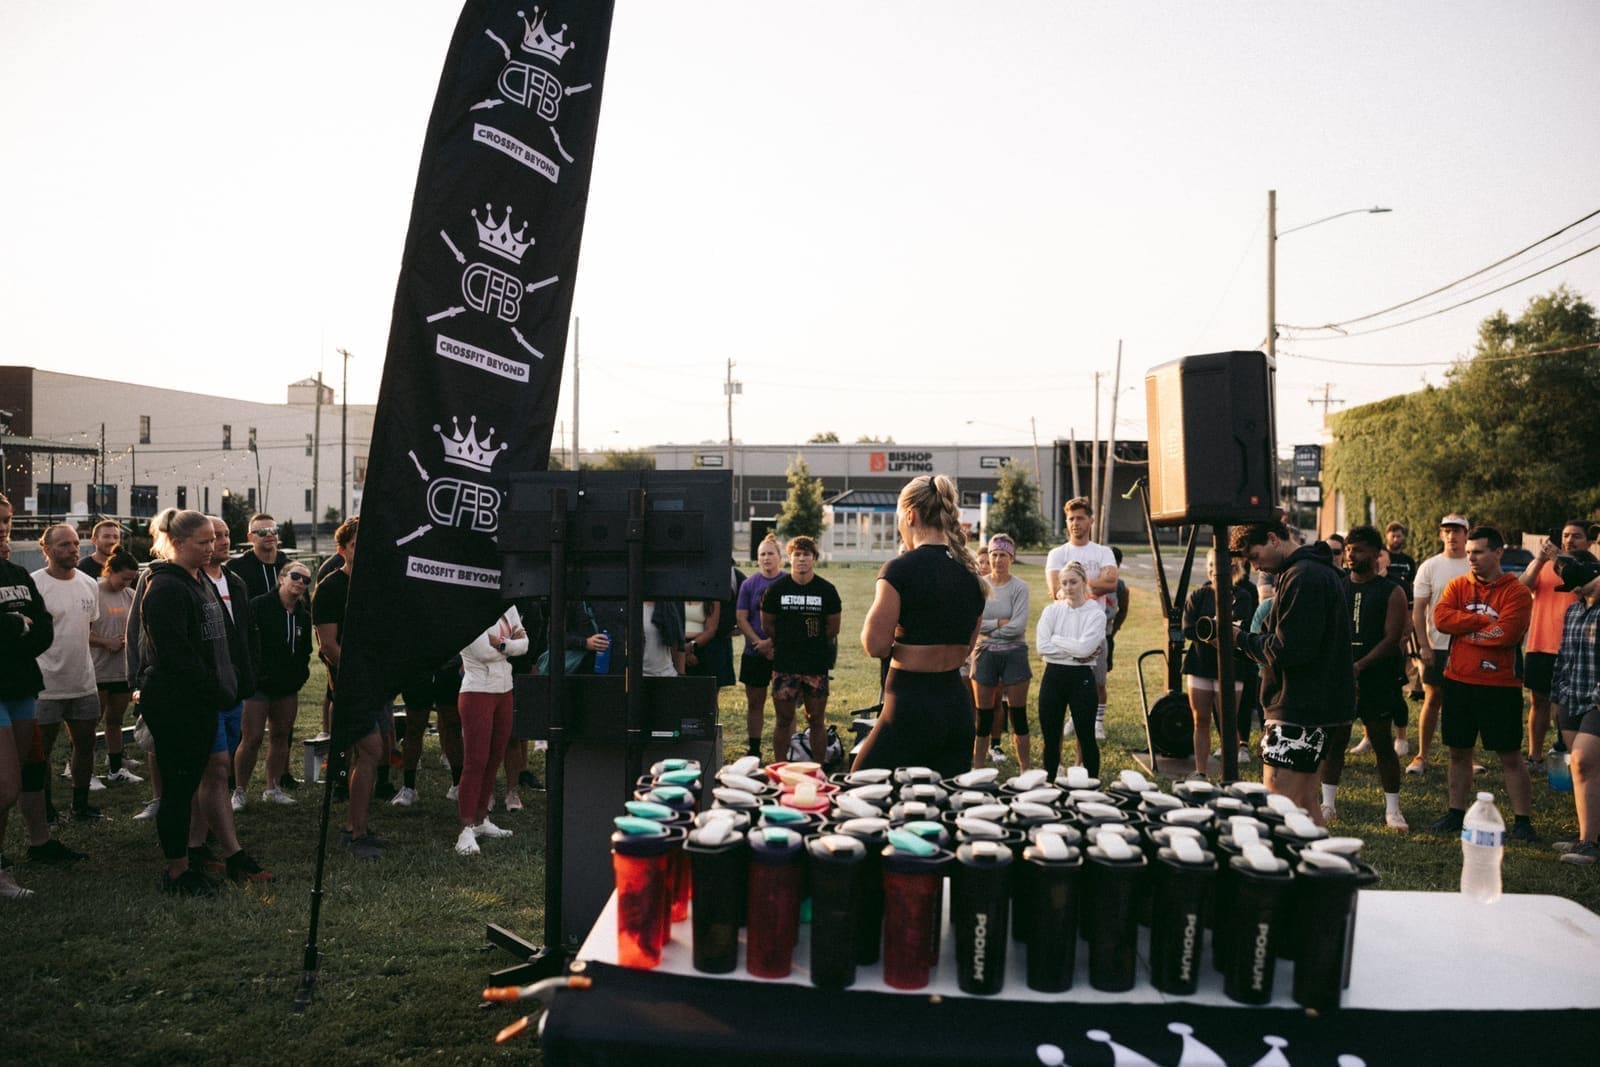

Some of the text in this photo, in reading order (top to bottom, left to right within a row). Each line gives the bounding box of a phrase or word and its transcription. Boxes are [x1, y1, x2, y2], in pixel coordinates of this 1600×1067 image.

[497, 60, 563, 121] CFB
[477, 128, 556, 177] CROSSFIT BEYOND
[461, 262, 524, 323] CFB
[440, 341, 525, 377] CROSSFIT BEYOND
[888, 452, 933, 462] BISHOP
[888, 463, 933, 472] LIFTING
[426, 477, 501, 533] CFB
[411, 562, 455, 578] CROSSFIT
[973, 913, 987, 983] PODIUM
[1180, 914, 1197, 982] PODIUM
[1251, 923, 1269, 991] PODIUM
